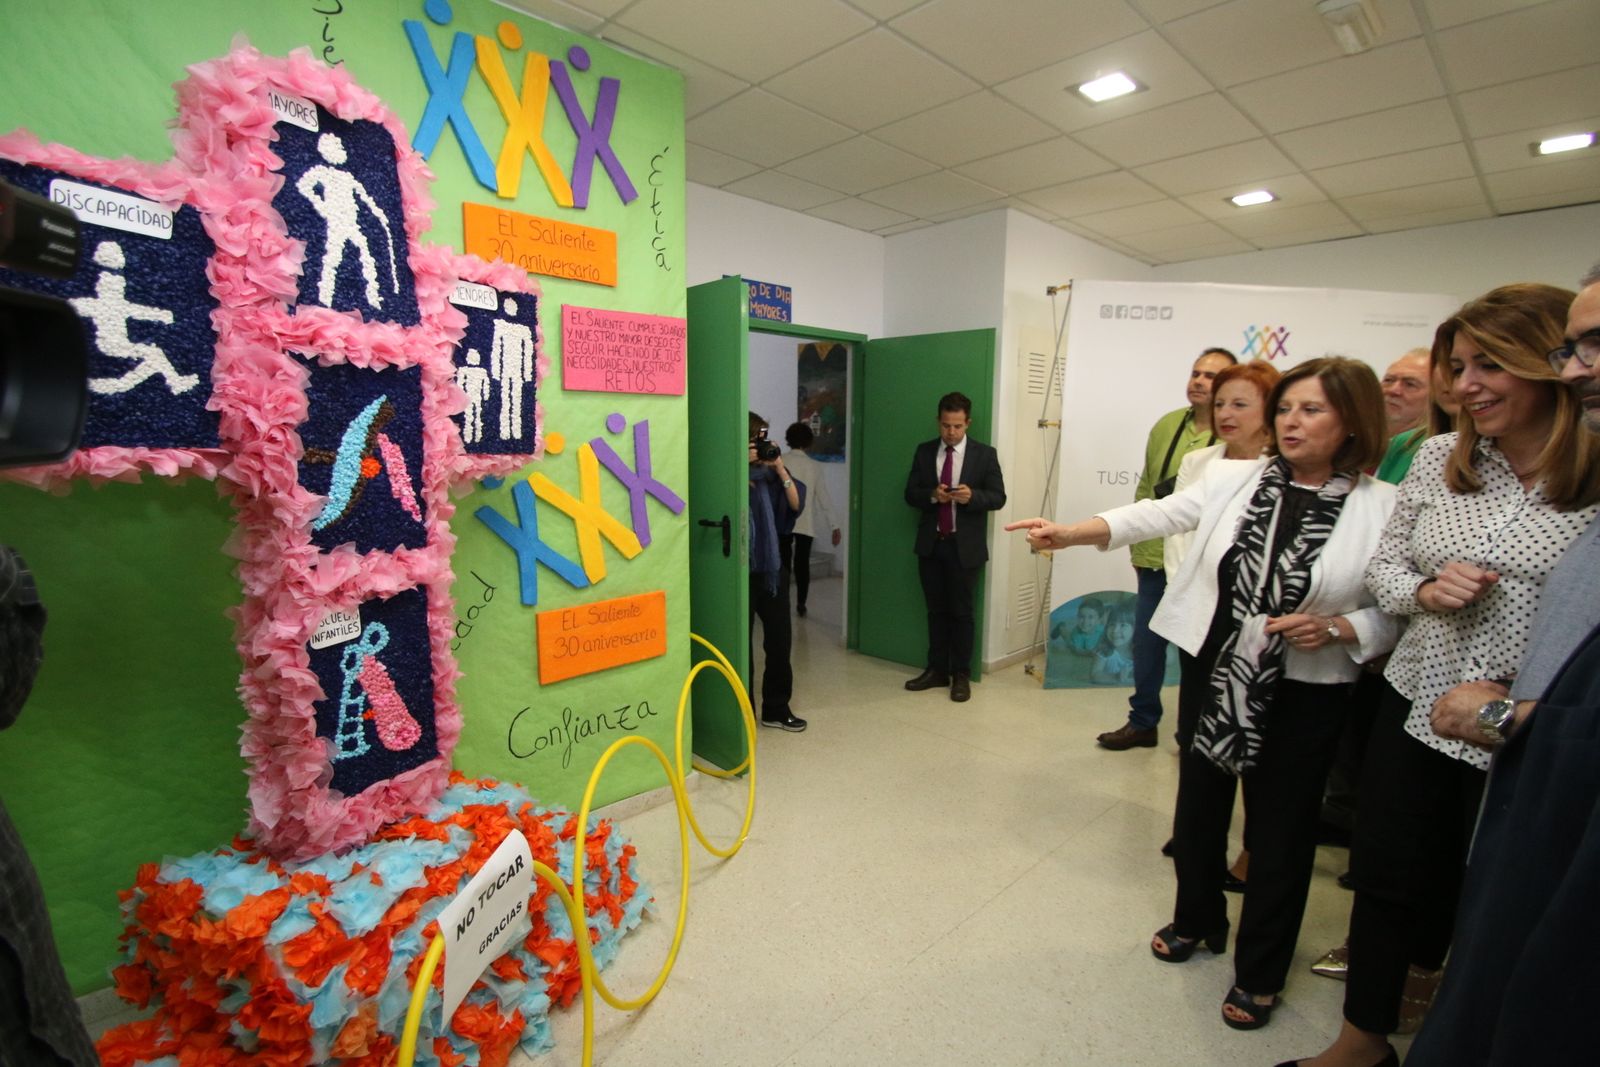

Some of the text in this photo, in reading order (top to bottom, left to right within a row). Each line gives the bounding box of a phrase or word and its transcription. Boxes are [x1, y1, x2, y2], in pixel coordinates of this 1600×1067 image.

[529, 219, 597, 252] Saliente
[486, 238, 600, 281] 30 aniversario
[760, 283, 771, 299] DE
[566, 328, 681, 350] Y NUESTRO MAYOR DESEO ES
[628, 320, 656, 335] CUMPLE
[567, 340, 605, 356] SEGUIR
[607, 343, 650, 359] HACIENDO
[604, 369, 656, 392] RETOS
[1096, 470, 1129, 485] TUS
[588, 603, 643, 625] Saliente
[552, 628, 657, 659] 30 aniversario
[508, 701, 658, 769] Confianza
[456, 854, 525, 942] NO TOCAR
[478, 901, 523, 955] GRACIAS
